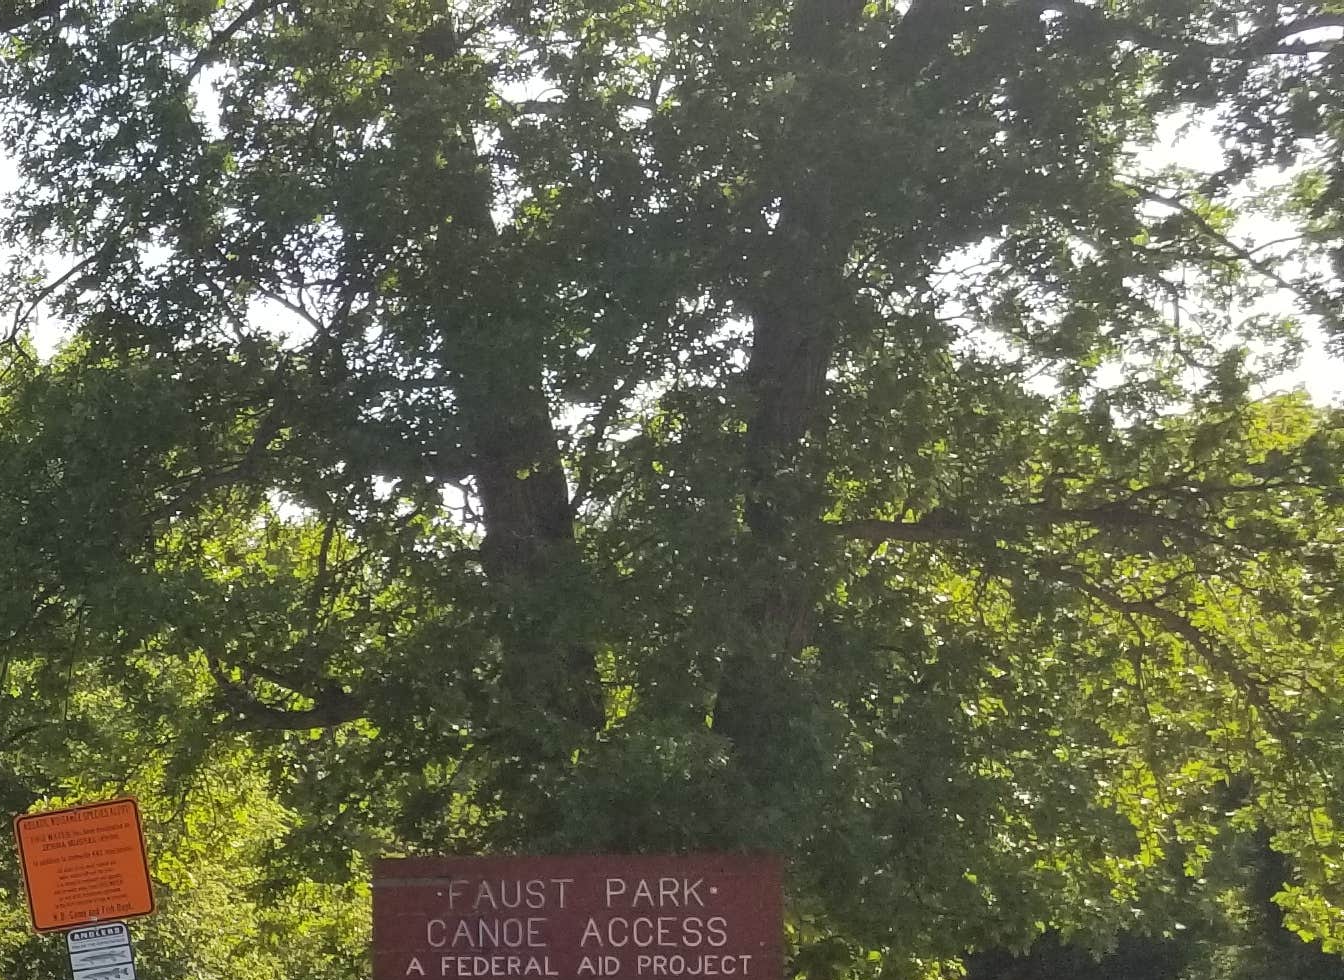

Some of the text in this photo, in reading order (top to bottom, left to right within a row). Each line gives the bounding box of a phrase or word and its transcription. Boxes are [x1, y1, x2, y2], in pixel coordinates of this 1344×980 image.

[447, 877, 706, 910] FAUST PARK
[427, 917, 728, 948] CANOE ACCESS
[405, 954, 753, 977] A FEDERAL AID PROJECT
